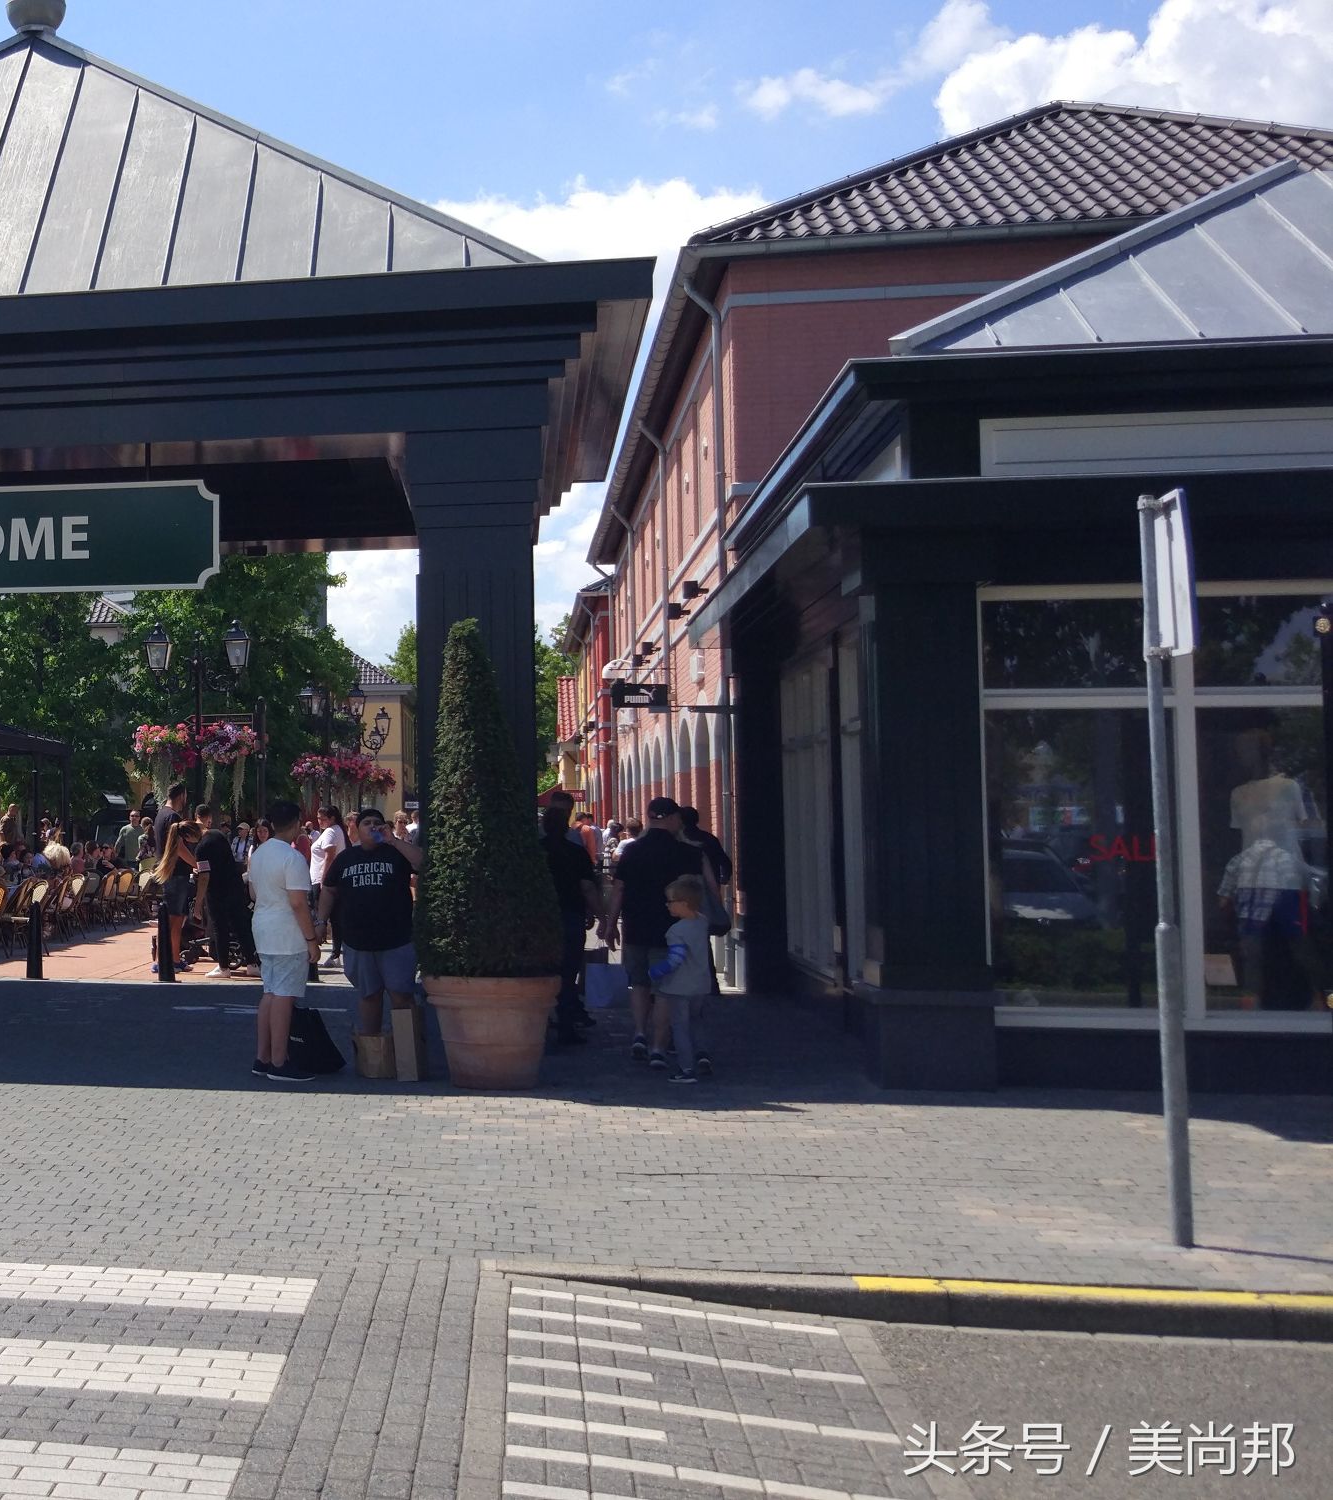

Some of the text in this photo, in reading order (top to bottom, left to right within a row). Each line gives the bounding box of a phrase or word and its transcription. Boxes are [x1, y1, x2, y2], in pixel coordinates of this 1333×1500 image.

[624, 695, 650, 704] PUMA
[341, 861, 393, 879] AMERICAN
[352, 873, 383, 888] EAGLE
